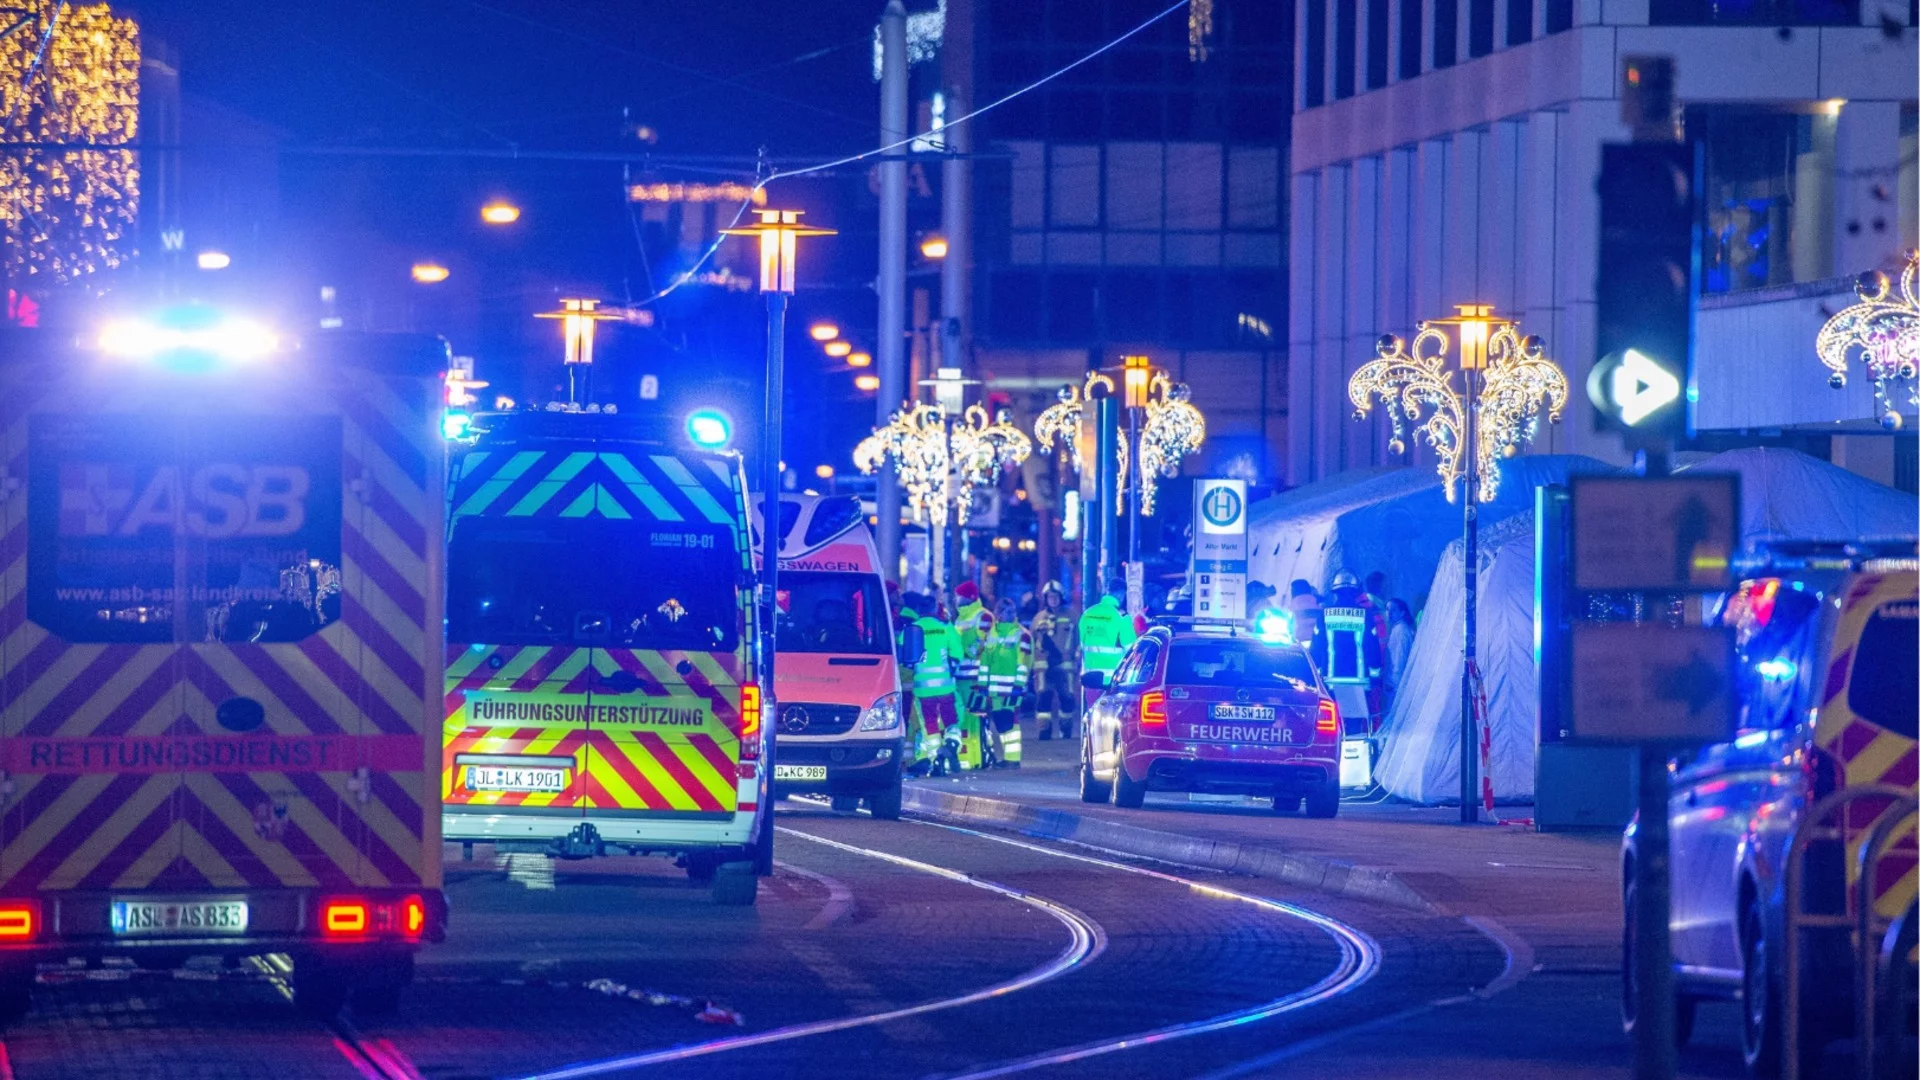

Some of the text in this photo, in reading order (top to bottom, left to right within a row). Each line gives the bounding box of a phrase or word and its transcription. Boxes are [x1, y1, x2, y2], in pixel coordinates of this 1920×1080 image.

[121, 464, 309, 538] ASB
[1214, 495, 1230, 518] H
[684, 533, 714, 549] 19-01
[1325, 608, 1365, 617] FEUERWEHR
[473, 698, 704, 727] FÜHRUNGSUNTERSTÜTZUNG
[1215, 706, 1274, 720] SBK SW 112
[1190, 724, 1293, 743] FEUERWEHR
[30, 740, 333, 768] RETTUNGSDIENST
[477, 770, 561, 787] JL LK 1901
[790, 767, 804, 777] KC
[806, 767, 825, 778] 989
[129, 906, 163, 928] ASL
[180, 906, 202, 928] AS
